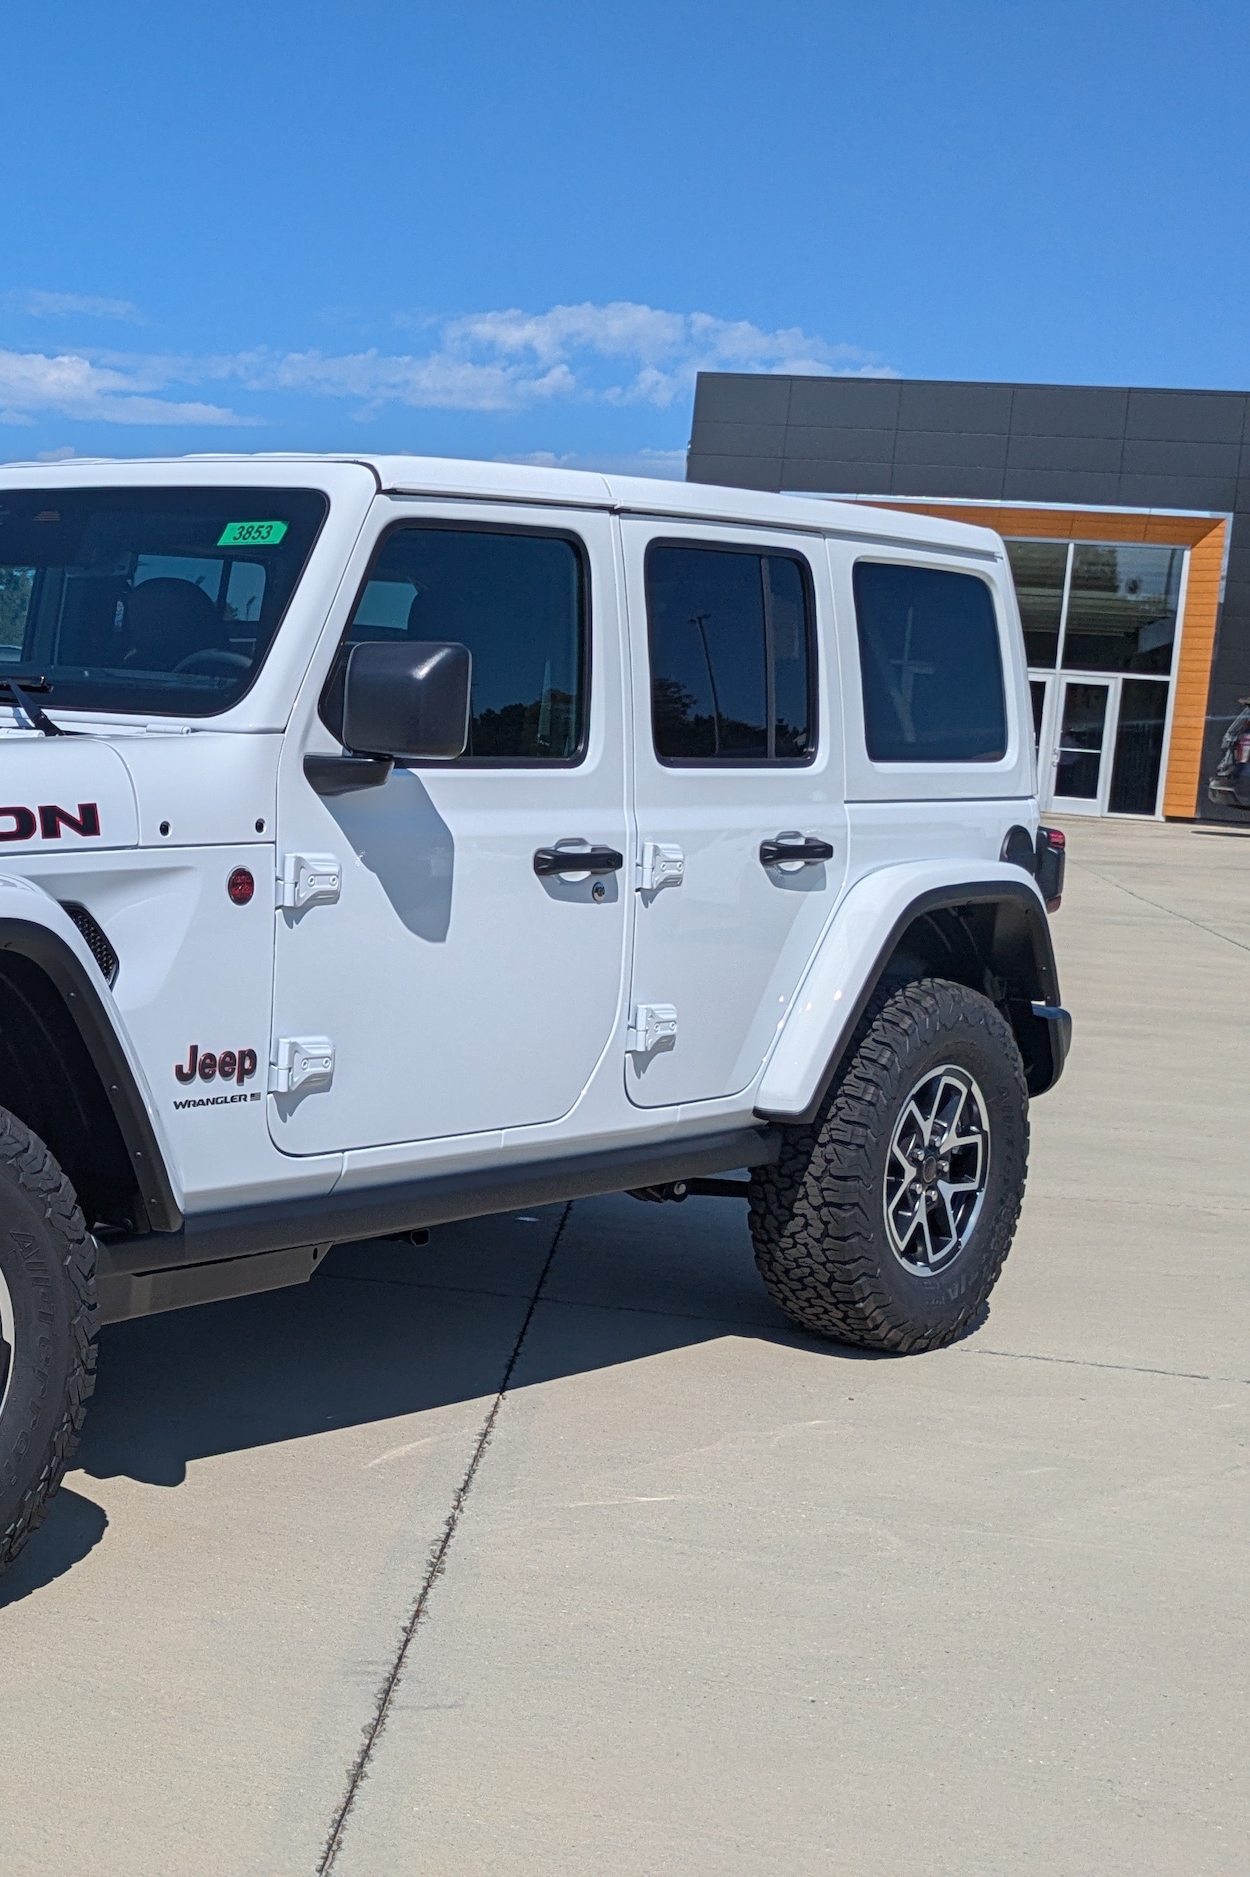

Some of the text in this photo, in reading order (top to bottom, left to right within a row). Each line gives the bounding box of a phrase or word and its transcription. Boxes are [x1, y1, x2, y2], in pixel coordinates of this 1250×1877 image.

[232, 524, 274, 541] 3853
[174, 1044, 258, 1085] Jeep
[173, 1093, 248, 1110] WRANGLER
